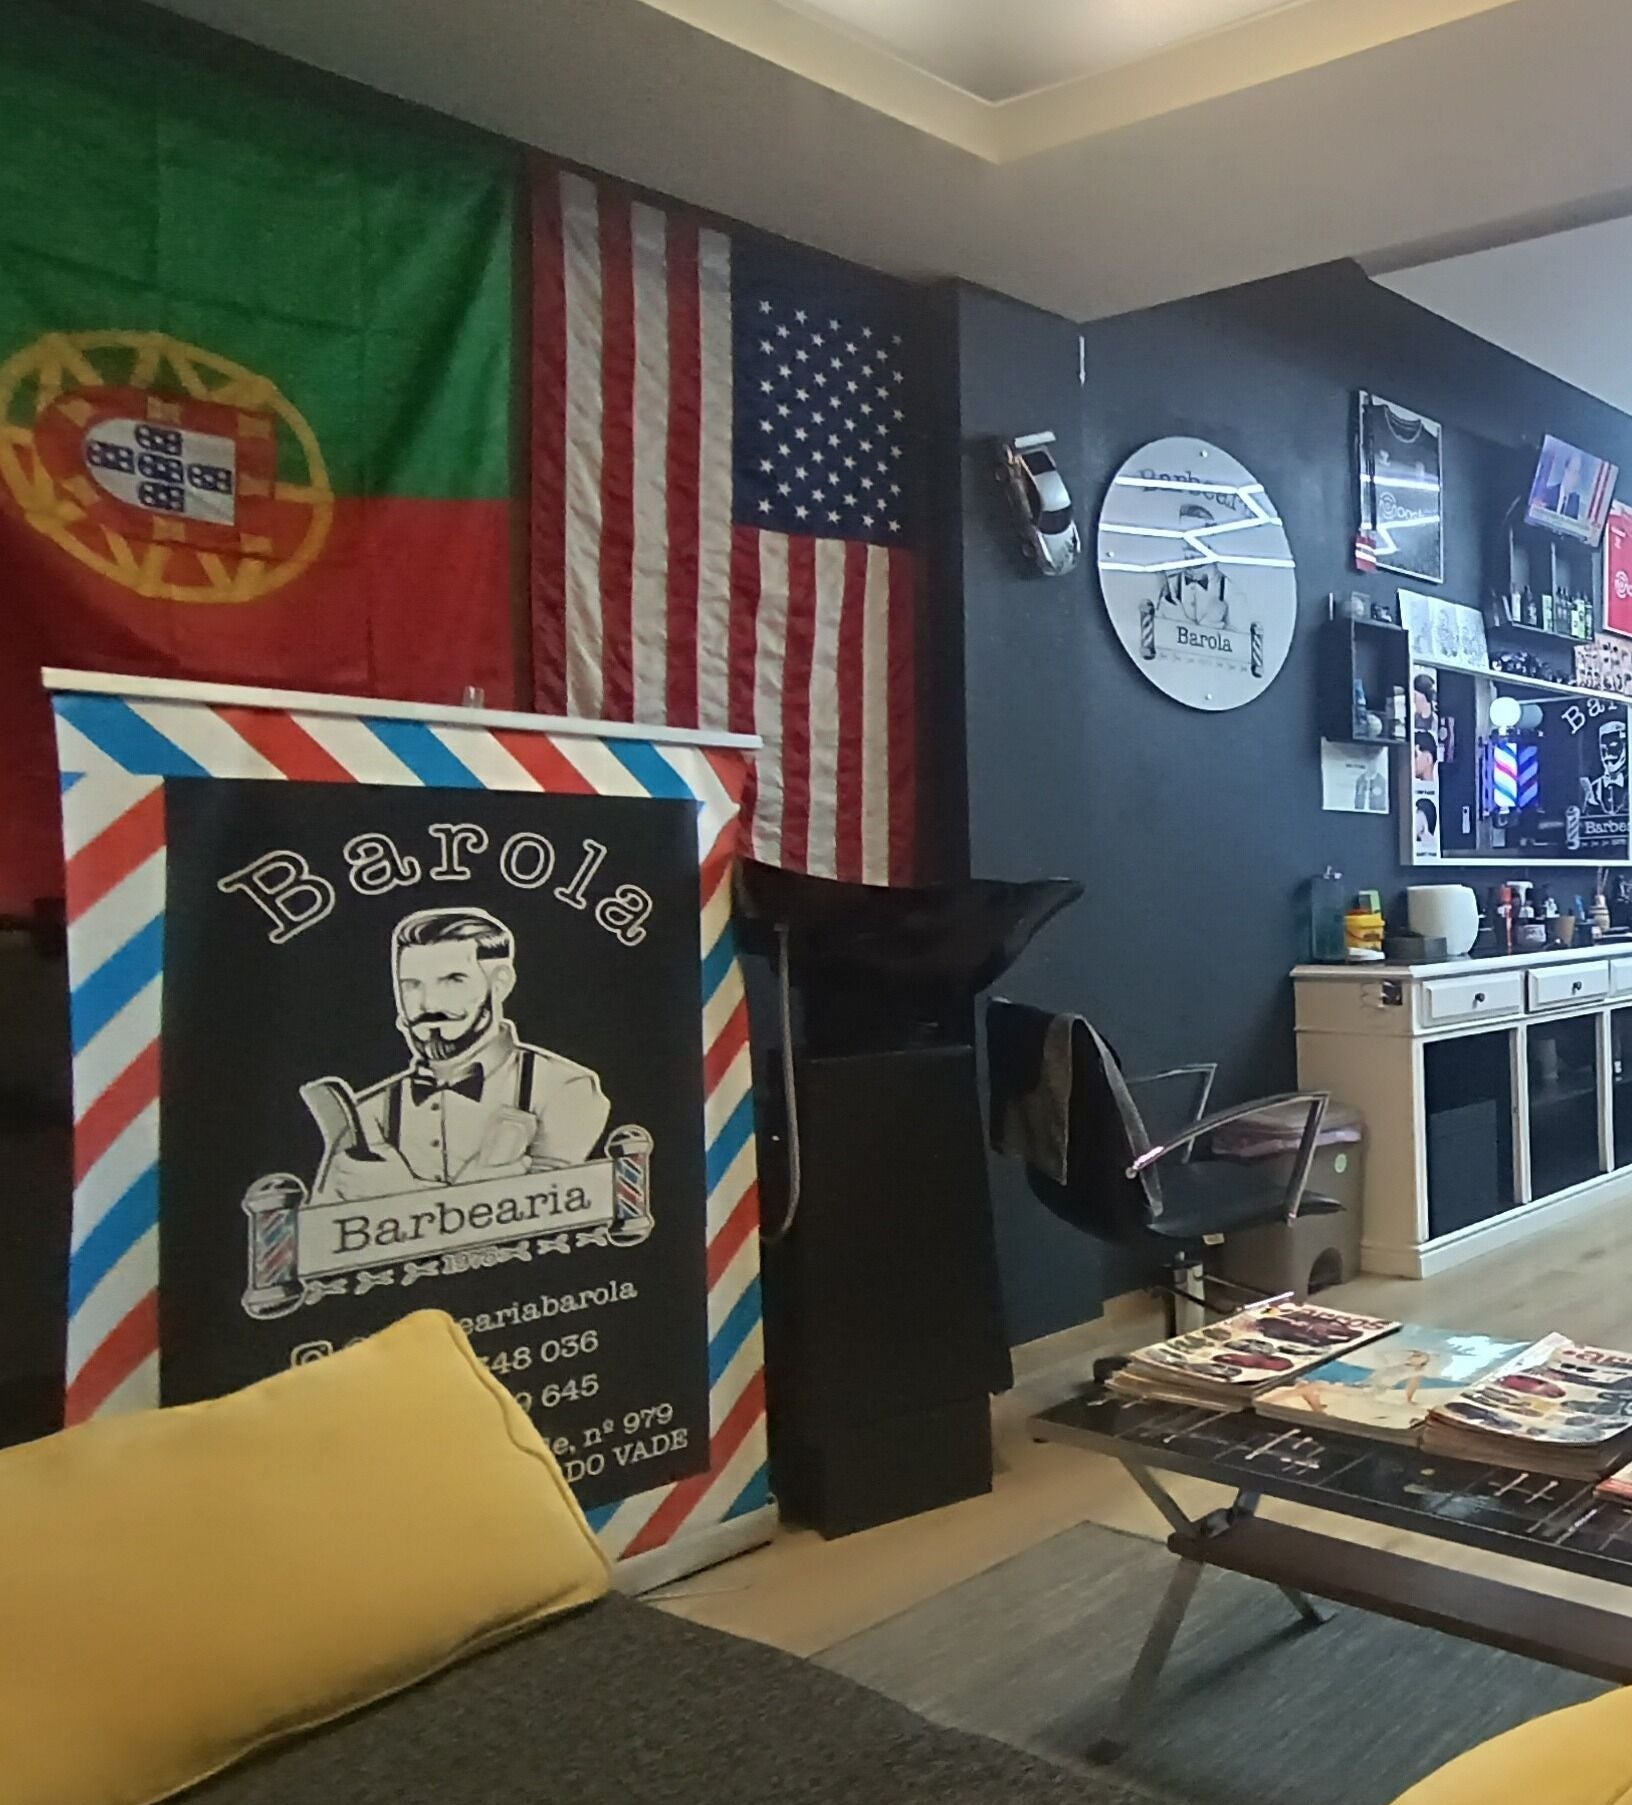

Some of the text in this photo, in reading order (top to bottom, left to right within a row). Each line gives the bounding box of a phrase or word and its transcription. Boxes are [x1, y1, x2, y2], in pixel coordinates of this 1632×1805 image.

[1176, 625, 1233, 653] Barola
[217, 823, 654, 946] Barola
[332, 1182, 591, 1254] Barbearia
[457, 1280, 639, 1336] eariabarola
[540, 1330, 599, 1363] 036
[541, 1374, 600, 1407] 645
[623, 1403, 673, 1435] 979
[563, 1428, 689, 1483] DO VADE
